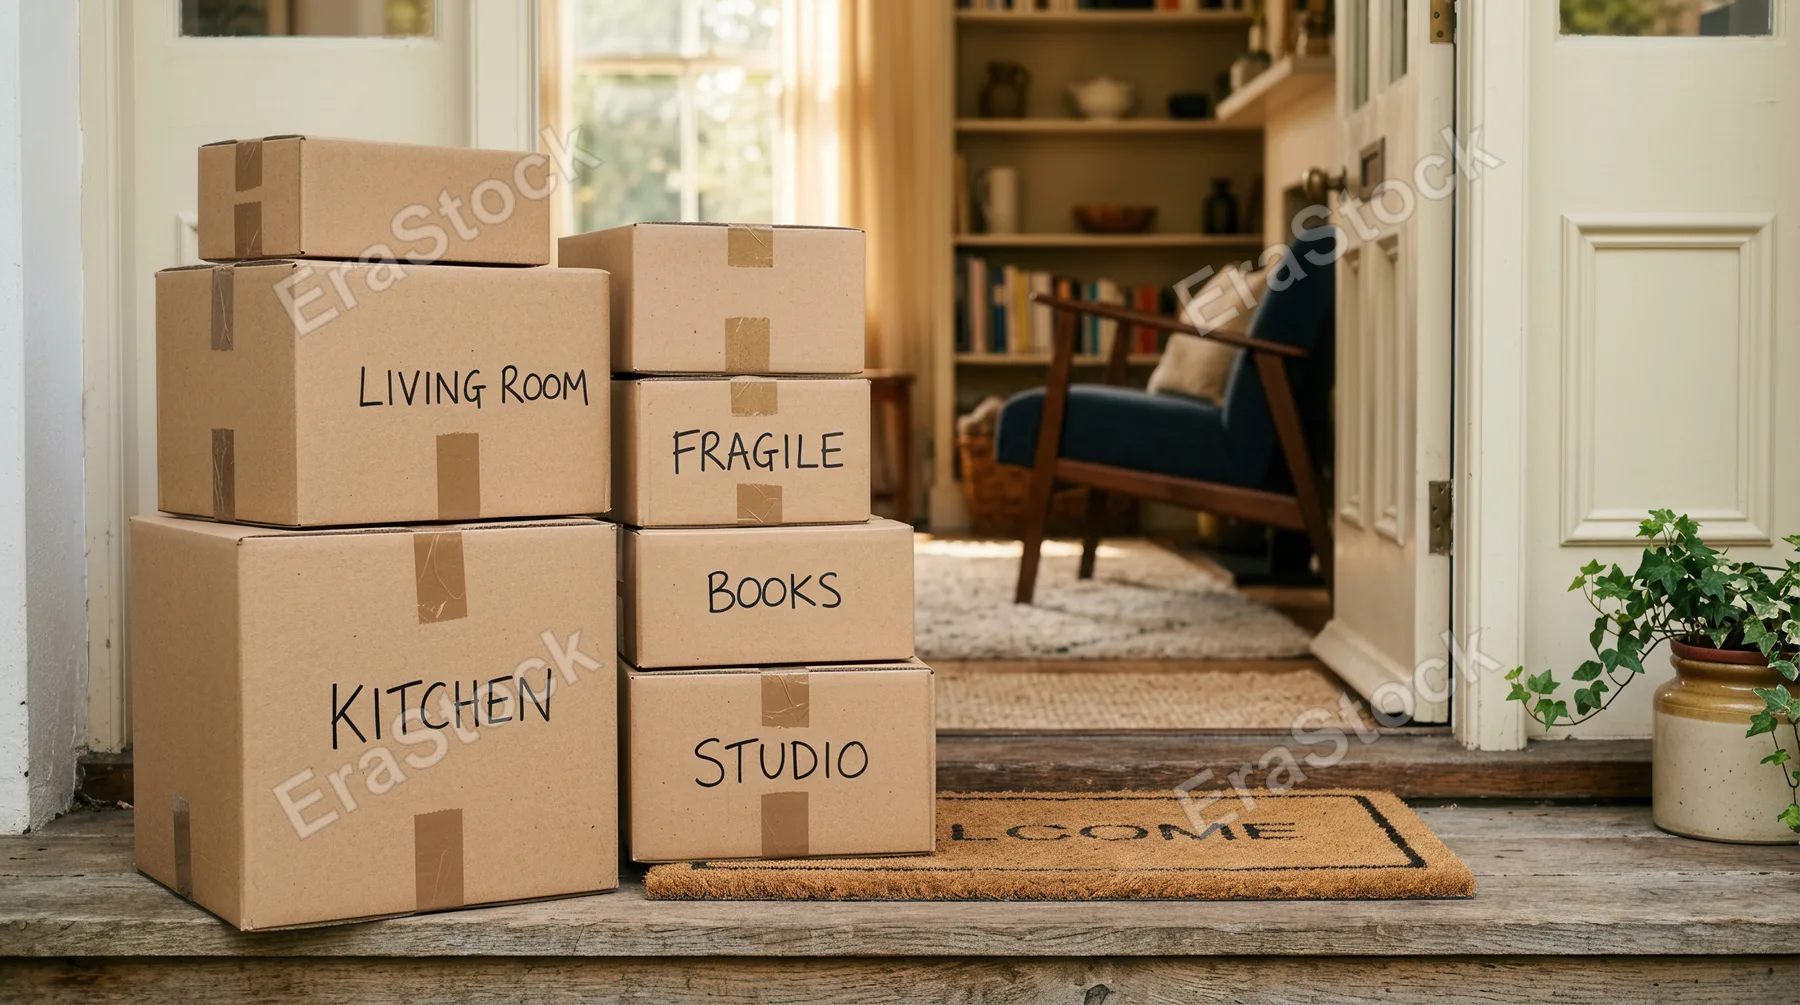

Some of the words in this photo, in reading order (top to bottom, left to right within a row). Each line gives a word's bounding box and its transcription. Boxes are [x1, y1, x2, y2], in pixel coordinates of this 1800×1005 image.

[359, 366, 487, 409] LIVING
[501, 364, 589, 406] ROOM
[672, 429, 844, 475] FRAGILE
[707, 570, 842, 614] BOOKS
[331, 667, 553, 750] KITCHEN
[694, 737, 869, 788] STUDIO
[936, 822, 1302, 842] LCOME
